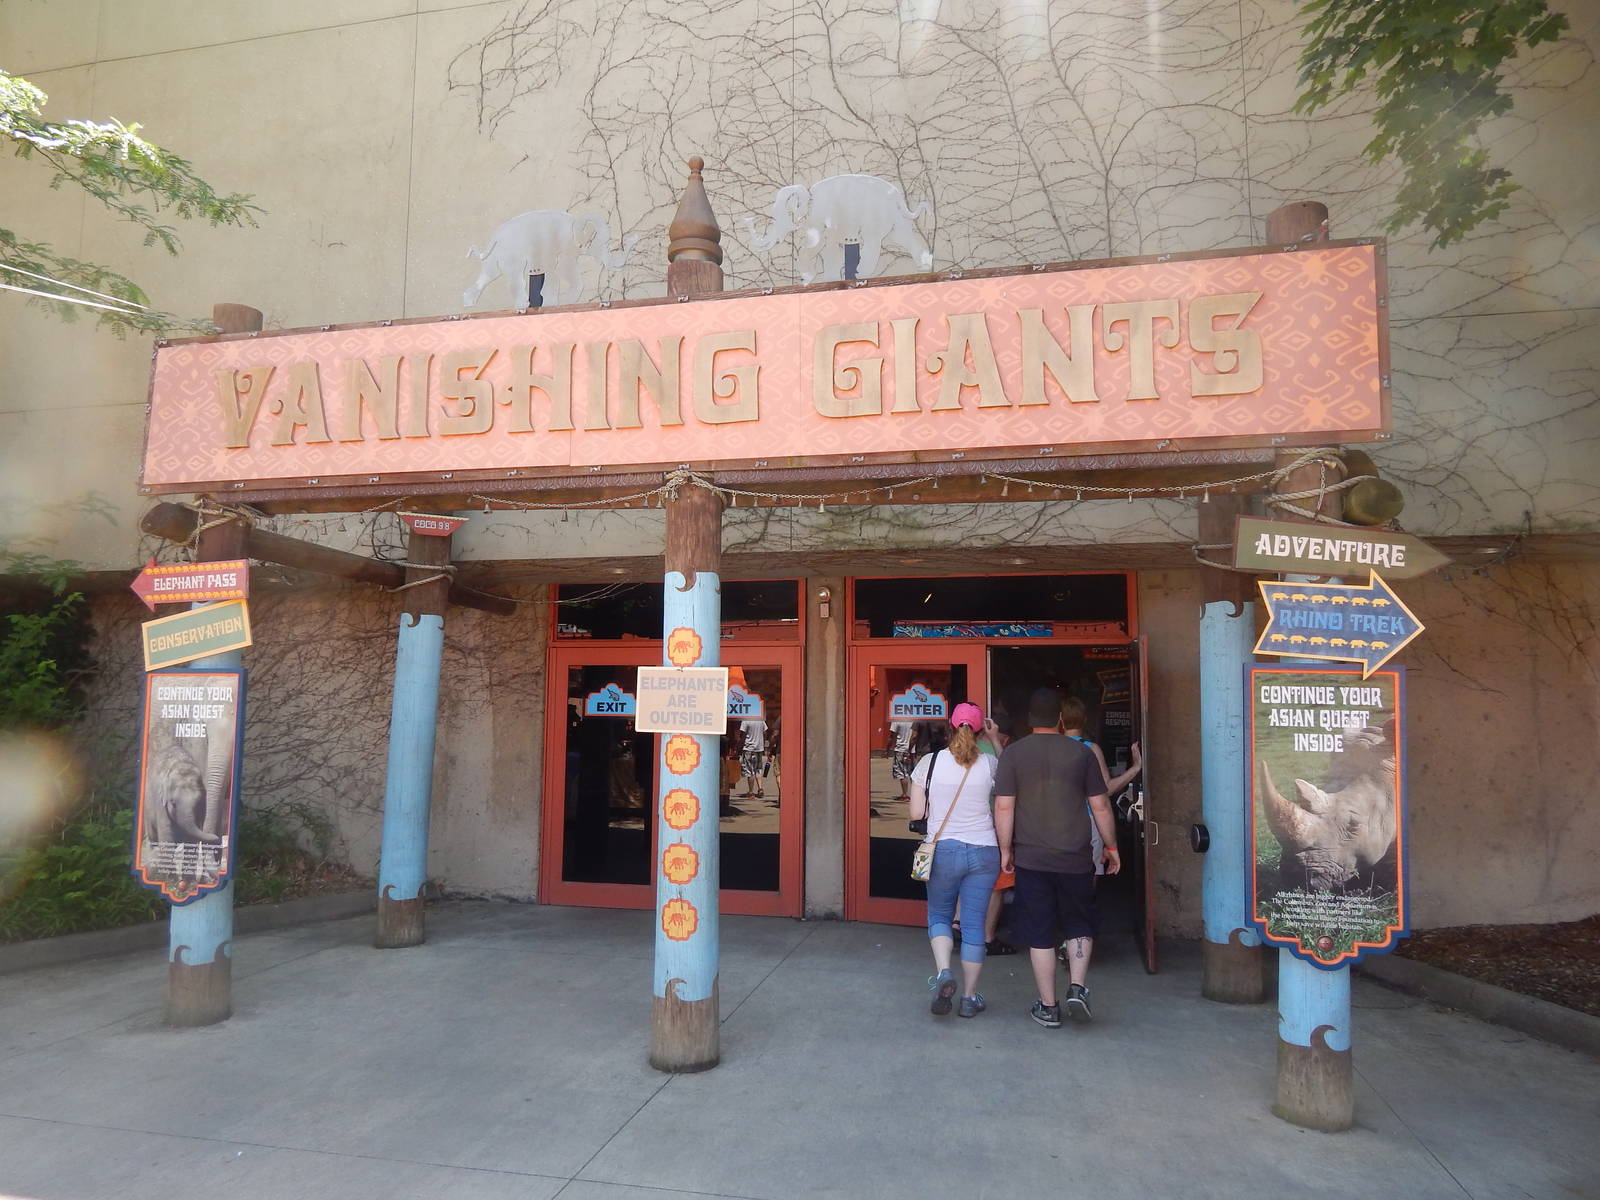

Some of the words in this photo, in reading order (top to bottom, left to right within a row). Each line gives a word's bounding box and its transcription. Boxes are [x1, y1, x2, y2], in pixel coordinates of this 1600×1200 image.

[216, 330, 761, 449] VANISHING
[813, 291, 1265, 419] GIANTS
[1255, 533, 1407, 568] ADVENTURE
[153, 575, 204, 592] ELEPHANT
[207, 573, 237, 588] PASS
[1279, 609, 1343, 631] RHINO
[1350, 614, 1406, 635] TREK
[150, 616, 242, 653] CONSERVATION
[640, 676, 725, 691] ELEPHANTS
[158, 686, 204, 701] CONTINUE
[207, 687, 233, 702] YOUR
[666, 694, 697, 708] ARE
[1260, 685, 1336, 704] CONTINUE
[1340, 687, 1383, 708] YOUR
[161, 704, 190, 719] ASIAN
[192, 704, 224, 722] QUEST
[596, 702, 627, 713] EXIT
[727, 703, 752, 714] XIT
[894, 704, 943, 715] ENTER
[650, 711, 713, 726] OUTSIDE
[1268, 708, 1315, 727] ASIAN
[1319, 709, 1370, 732] QUEST
[175, 723, 207, 738] INSIDE
[1294, 733, 1344, 752] INSIDE
